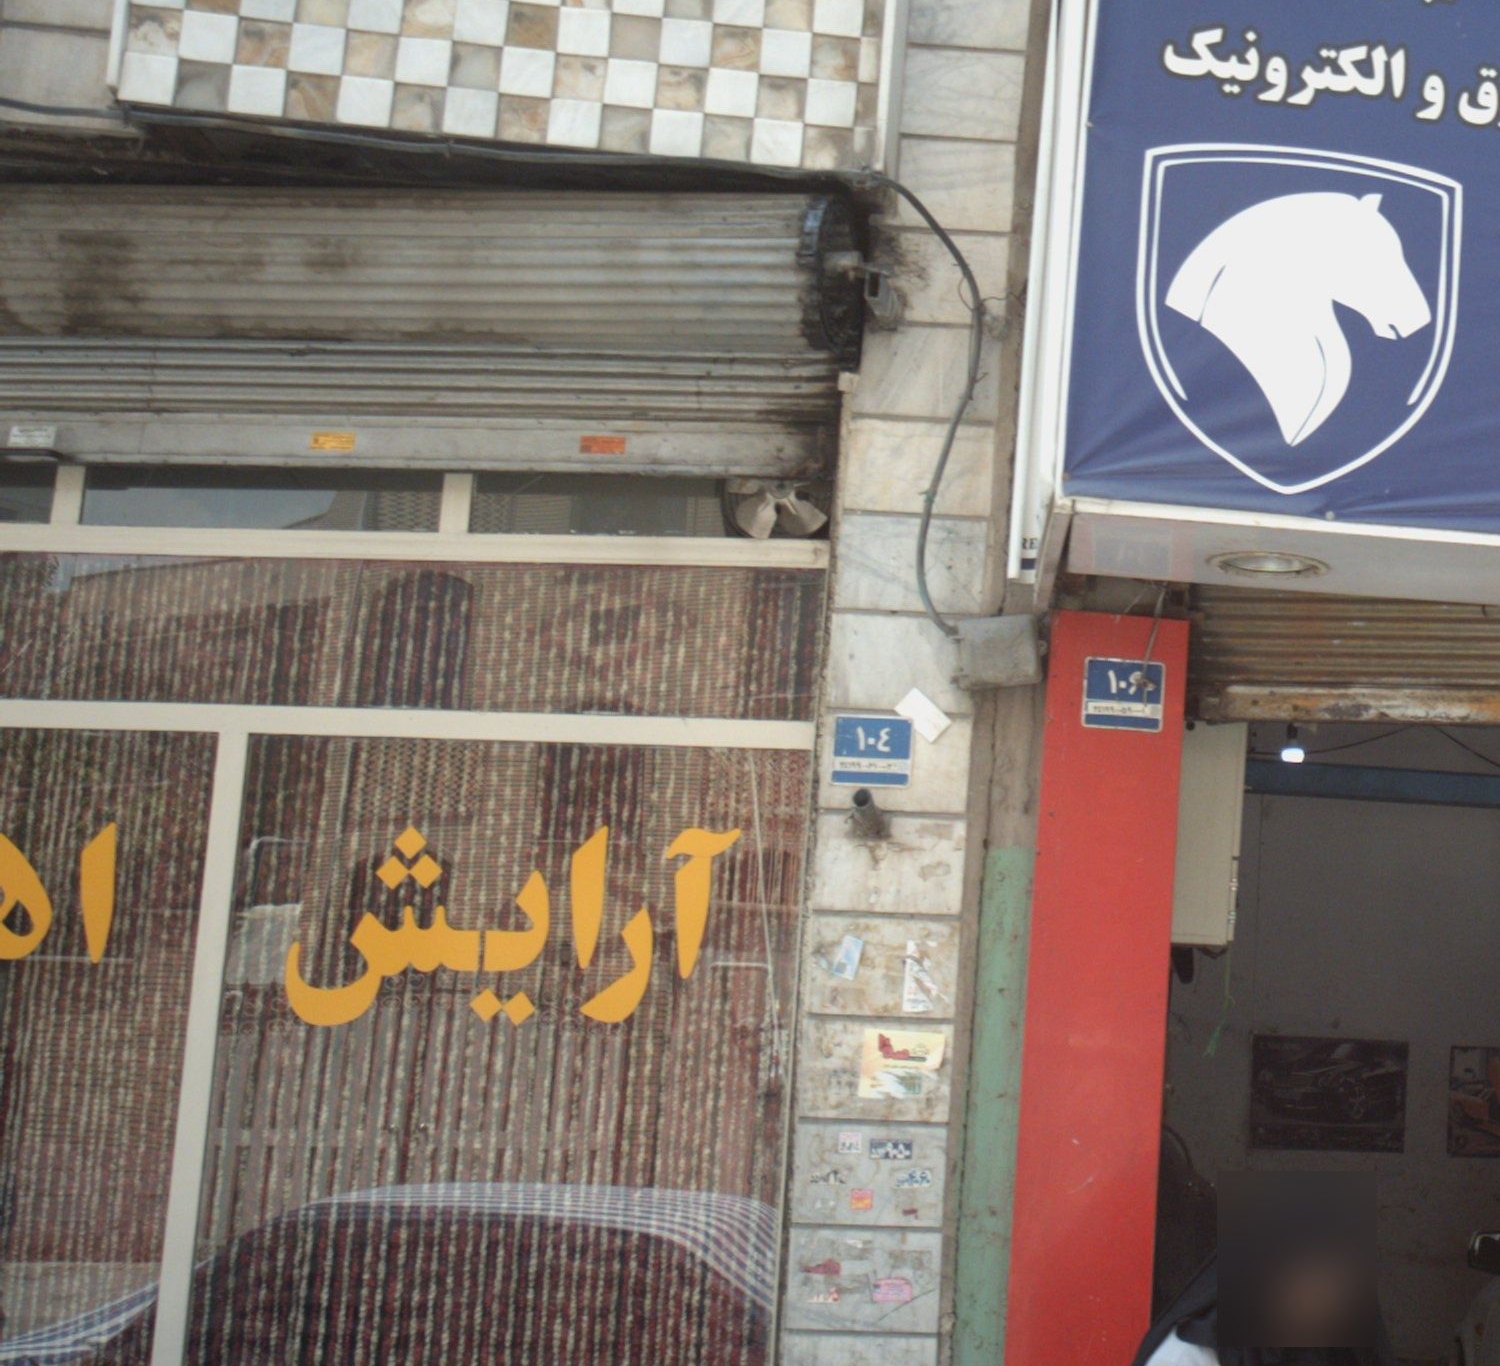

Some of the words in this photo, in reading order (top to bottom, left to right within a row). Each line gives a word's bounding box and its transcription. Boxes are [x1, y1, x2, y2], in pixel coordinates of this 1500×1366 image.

[1162, 28, 1406, 103] الکترونیک
[1417, 72, 1446, 120] و
[284, 825, 743, 1027] آرایش
